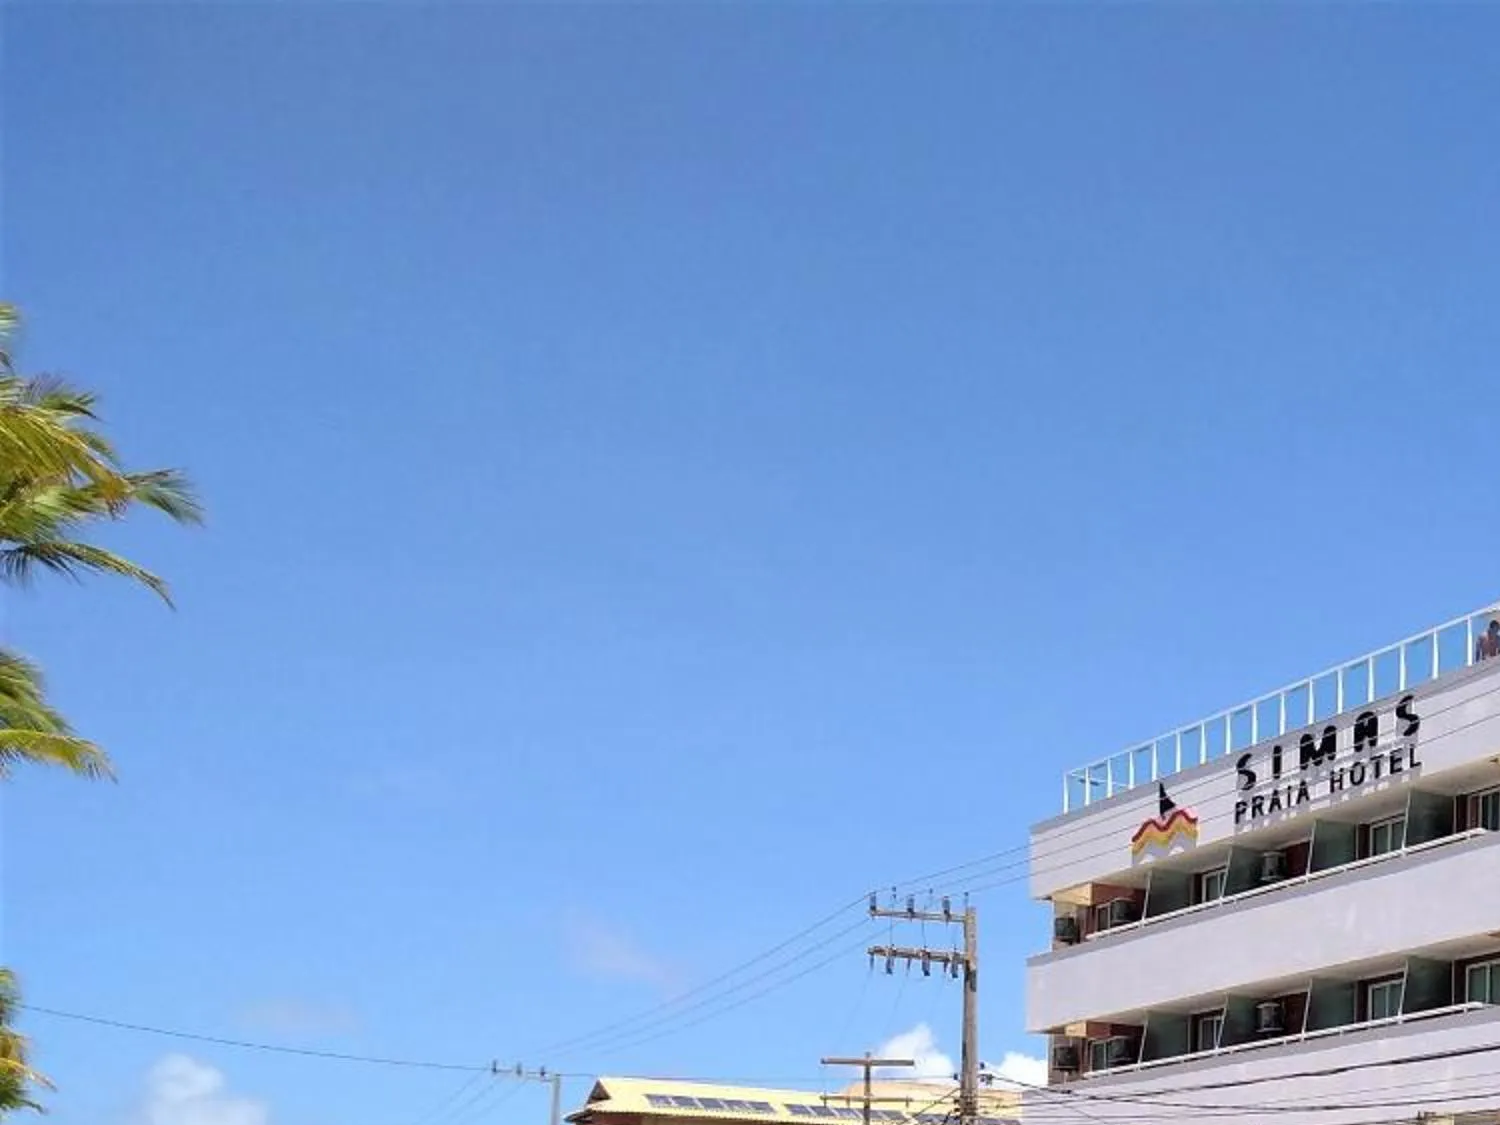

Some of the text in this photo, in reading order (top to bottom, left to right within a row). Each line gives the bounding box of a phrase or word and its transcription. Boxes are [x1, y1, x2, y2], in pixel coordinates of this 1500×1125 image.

[1234, 744, 1423, 824] PRAIA HOTEL
[1236, 695, 1420, 791] SIMAS
